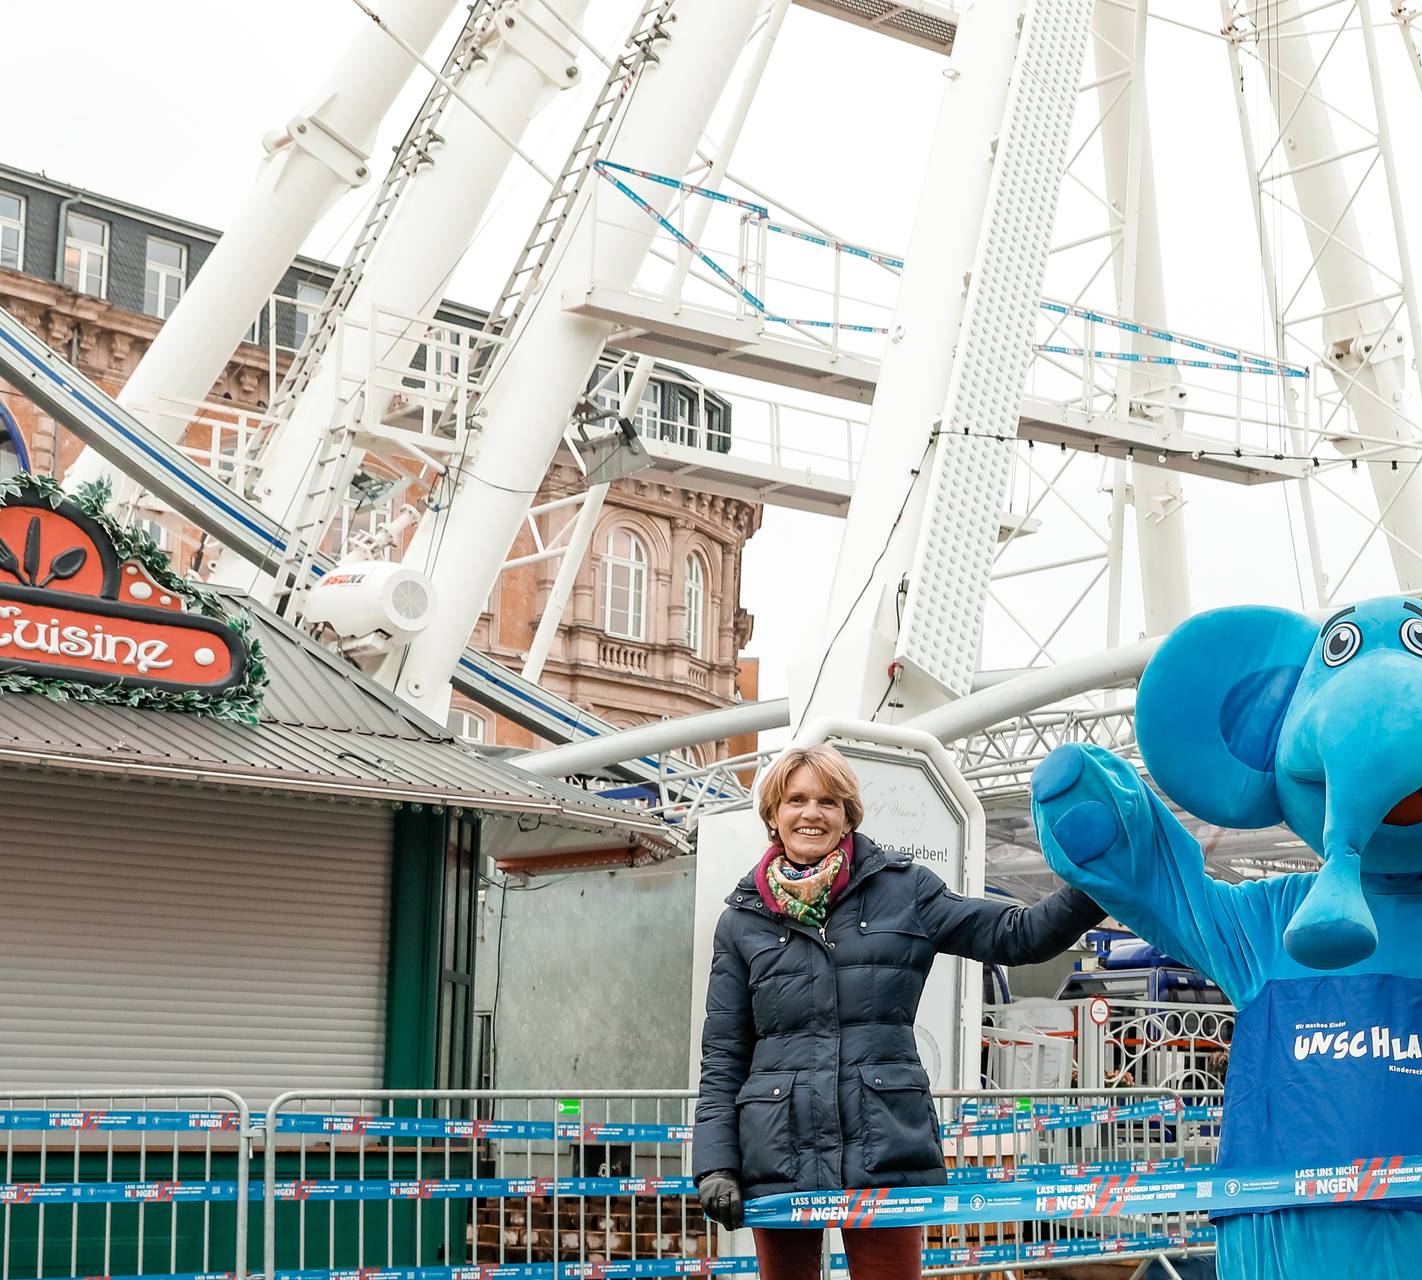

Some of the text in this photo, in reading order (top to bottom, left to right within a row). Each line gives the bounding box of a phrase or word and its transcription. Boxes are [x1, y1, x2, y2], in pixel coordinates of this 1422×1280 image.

[1296, 1166, 1359, 1178] LASS UNS NICHT
[1036, 1184, 1098, 1195] LASS UNS NICHT
[0, 1191, 17, 1199] GEN
[791, 1196, 850, 1206] LASS UNS NICHT
